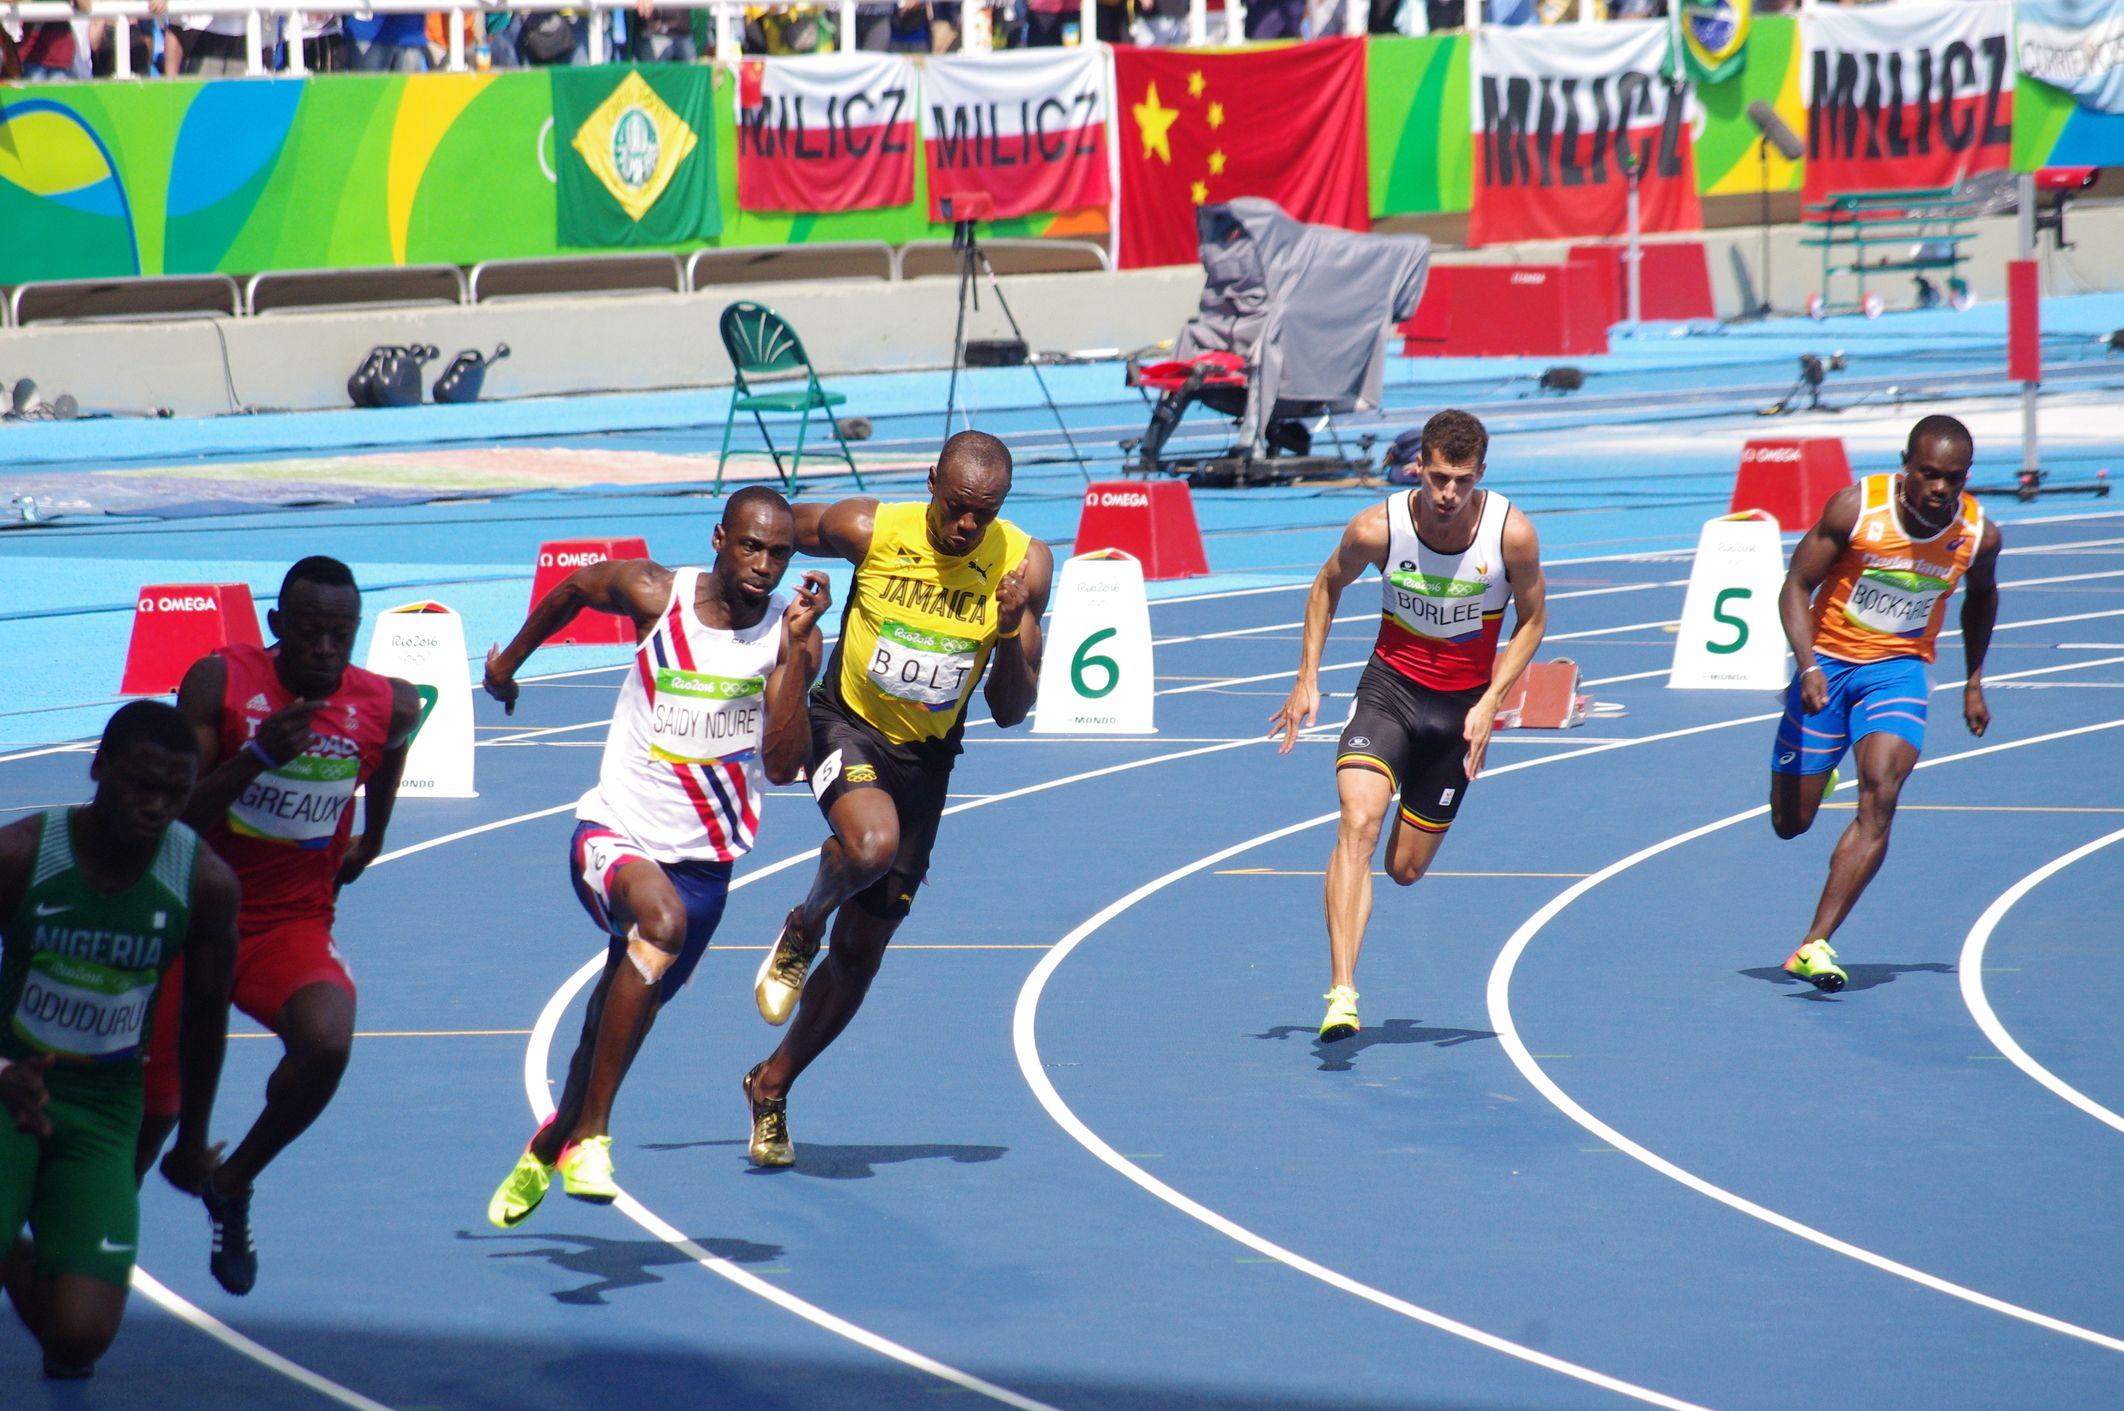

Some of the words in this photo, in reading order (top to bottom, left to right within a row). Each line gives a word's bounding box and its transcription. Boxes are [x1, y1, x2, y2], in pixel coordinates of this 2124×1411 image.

[1808, 35, 2012, 159] MILICZ
[740, 89, 906, 160] MILICZ
[932, 90, 1097, 169] MILICZ
[1482, 71, 1687, 187] MILICZ
[1755, 447, 1801, 462] OMEGA
[1101, 492, 1149, 507] OMEGA
[557, 552, 608, 567] OMEGA
[879, 575, 987, 626] JAMAICA
[1403, 577, 1441, 592] Rio2016
[159, 596, 217, 612] OMEGA
[1398, 591, 1481, 626] BORLEE
[1706, 587, 1752, 654] 5
[391, 635, 440, 648] Rio2016
[895, 627, 935, 647] Rio2016
[872, 647, 971, 690] BOLT
[1071, 627, 1119, 699] 6
[671, 677, 715, 693] Rio2016
[654, 704, 699, 738] SAIDY
[705, 708, 757, 739] NDURE
[1074, 716, 1117, 725] MONDO
[396, 779, 435, 789] ONDO
[240, 781, 348, 823] GREAUX
[594, 852, 606, 871] 6
[35, 924, 162, 967] NIGERIA
[24, 984, 144, 1037] ODUDURU
